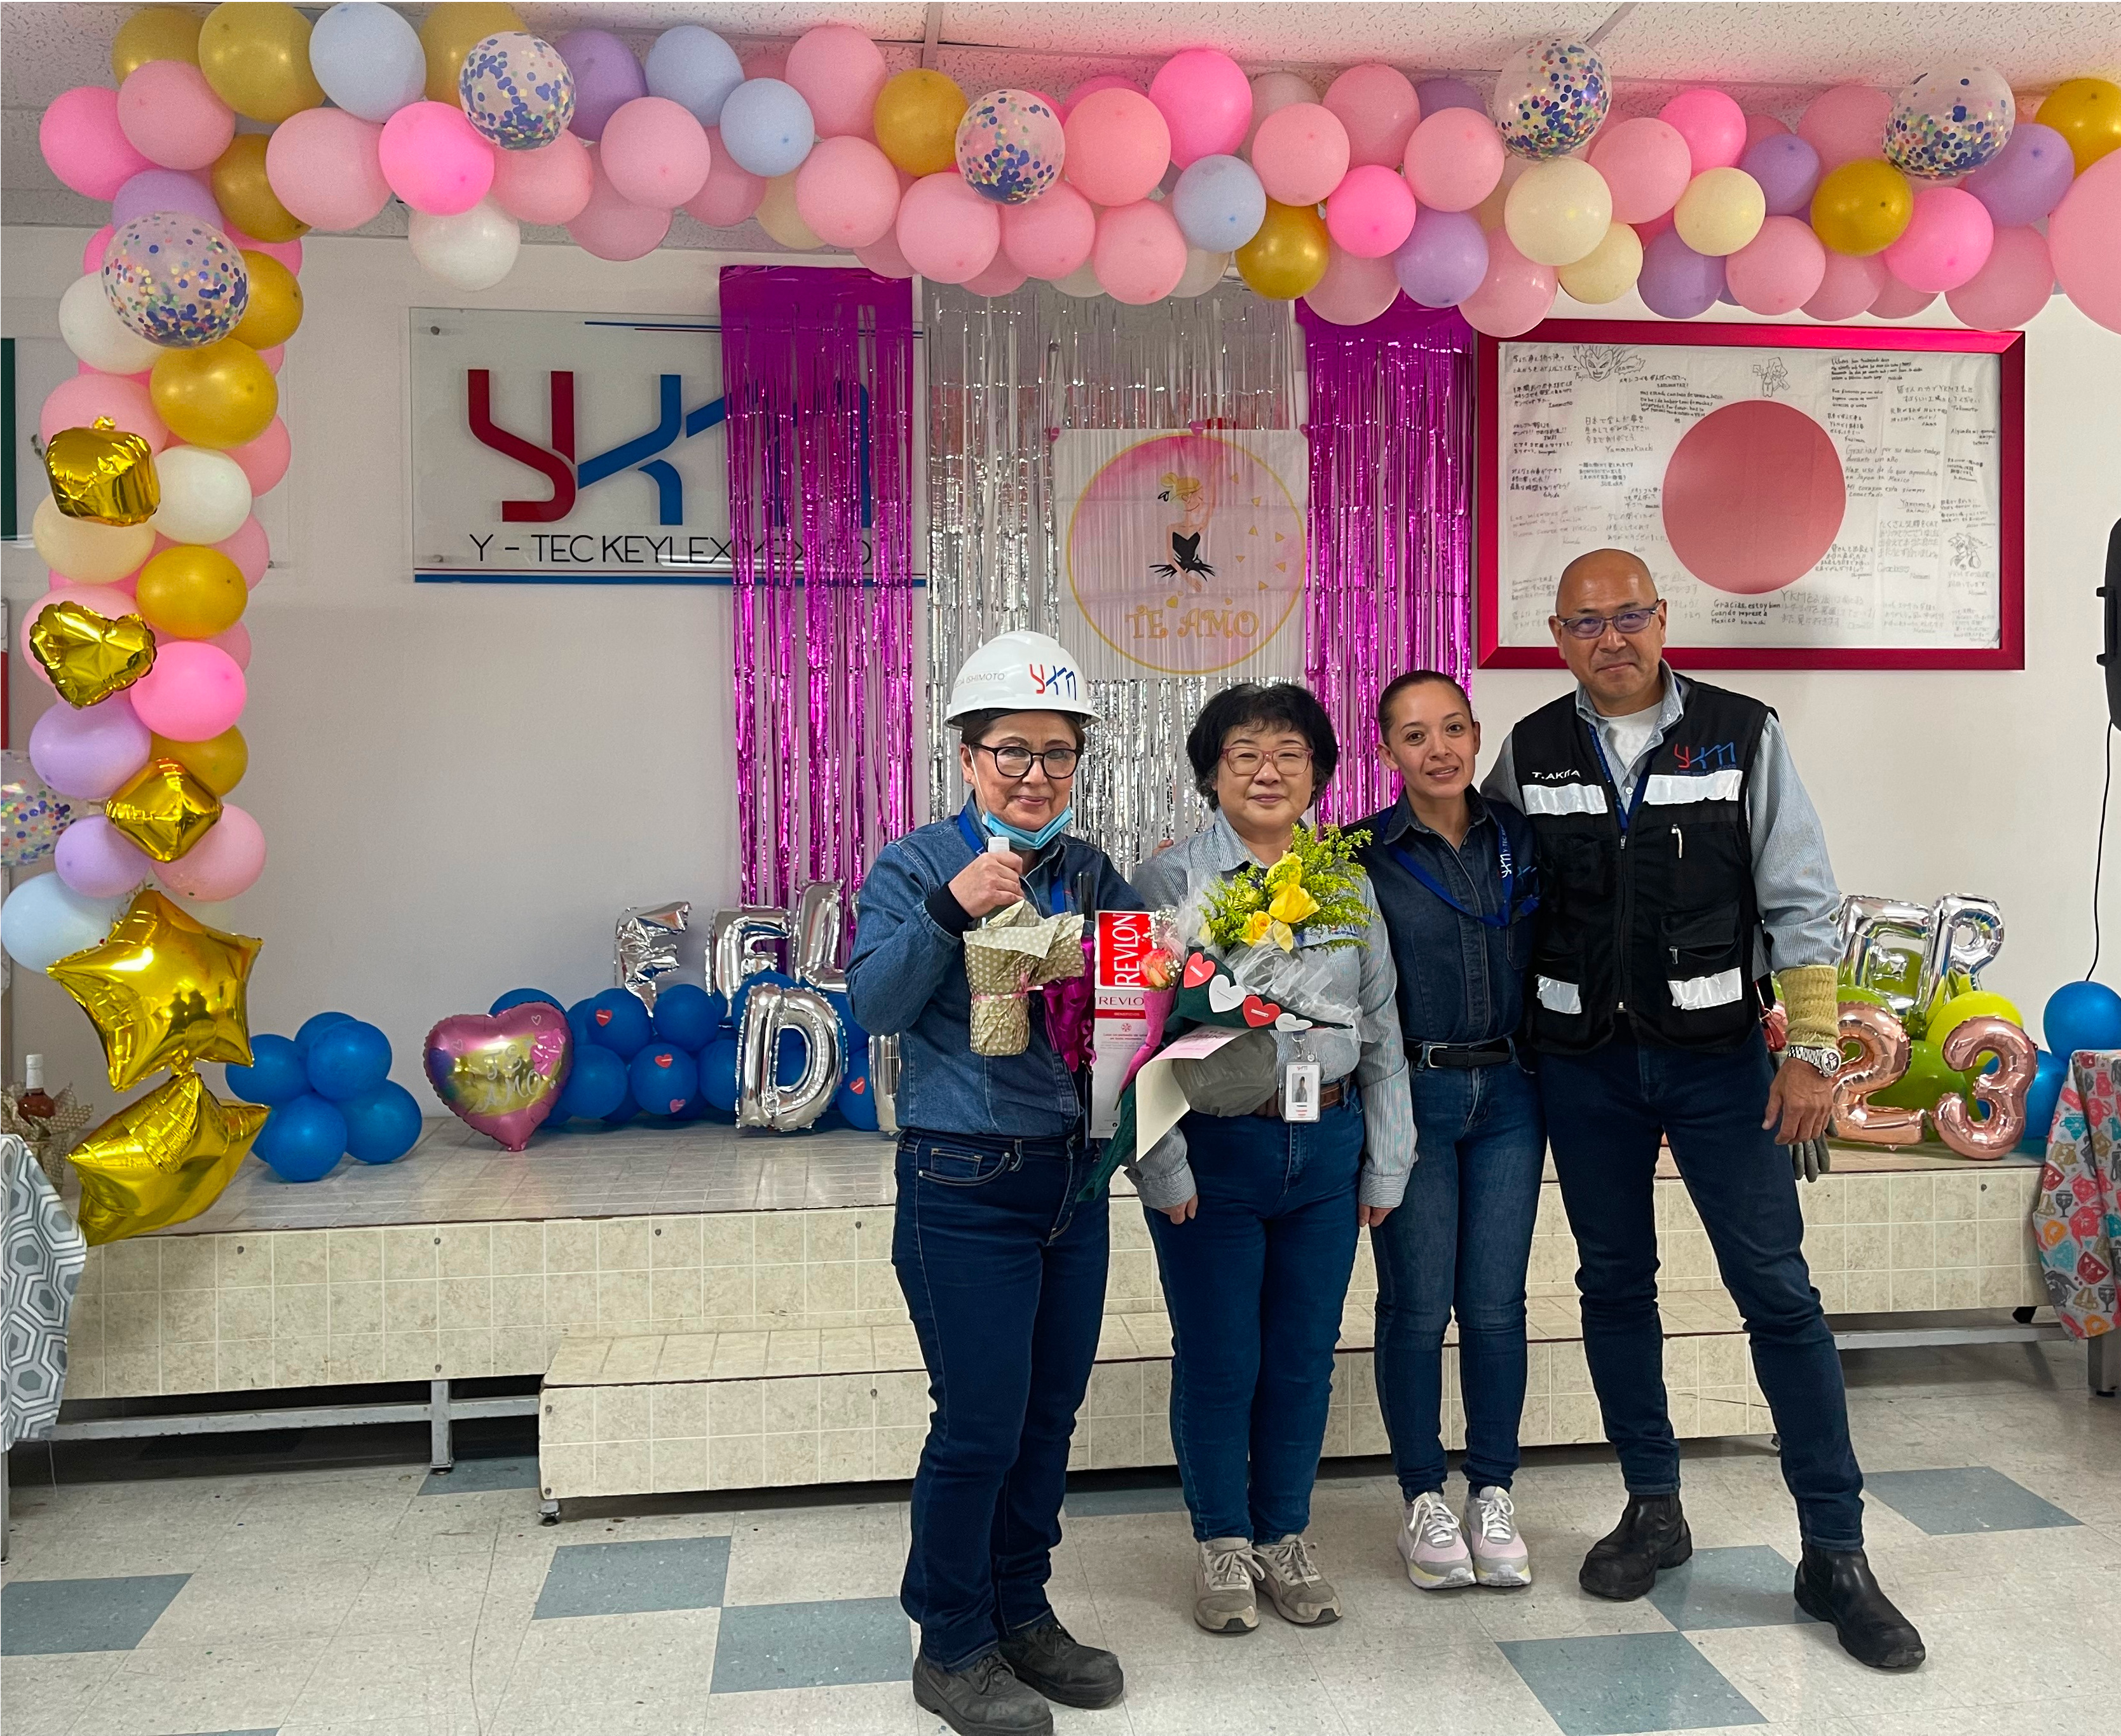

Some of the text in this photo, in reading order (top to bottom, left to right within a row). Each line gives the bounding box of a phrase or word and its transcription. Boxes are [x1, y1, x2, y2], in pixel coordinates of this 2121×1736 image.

[470, 534, 493, 561] Y
[531, 534, 594, 563] TEC
[601, 535, 732, 564] KEYLEX
[1126, 605, 1259, 639] TE AMO
[1112, 913, 1141, 986] REVLON
[1098, 996, 1145, 1006] REVLO
